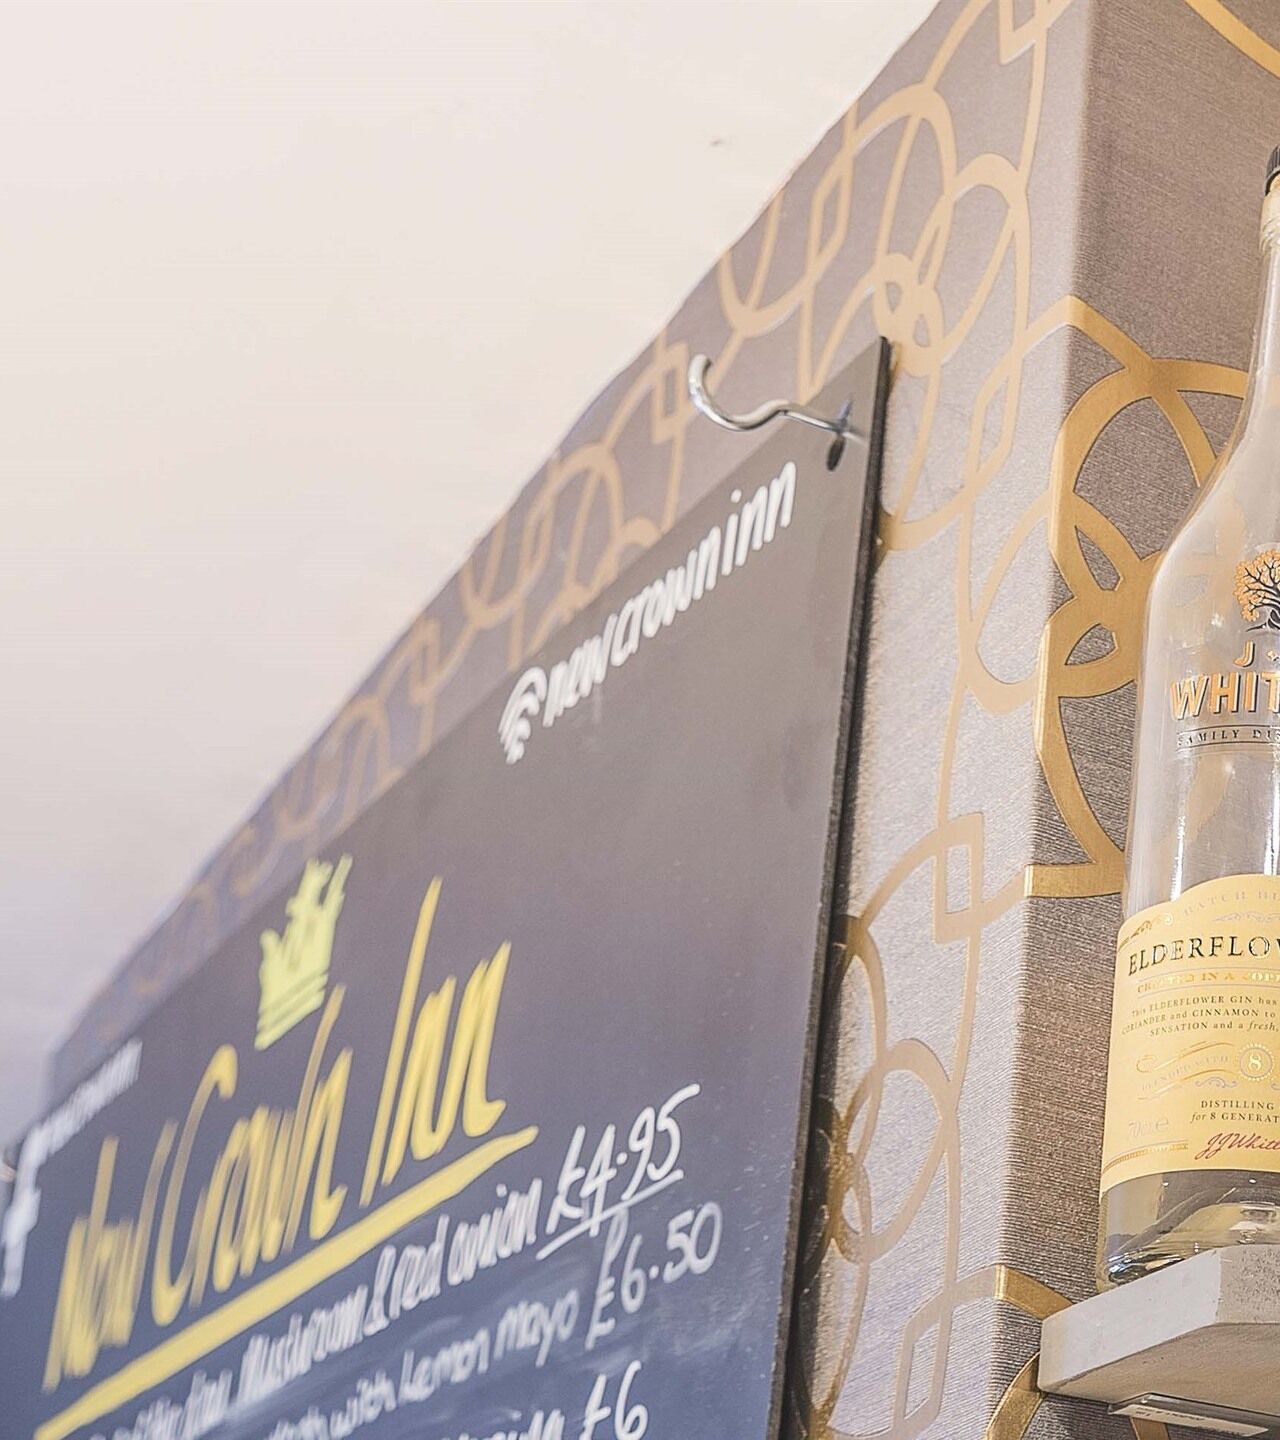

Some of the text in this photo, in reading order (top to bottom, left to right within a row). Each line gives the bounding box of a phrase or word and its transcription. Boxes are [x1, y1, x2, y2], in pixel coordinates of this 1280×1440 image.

[1190, 1112, 1207, 1125] for
[1209, 1111, 1217, 1120] 8
[1200, 1099, 1275, 1112] DISTILLING
[548, 1083, 701, 1237] £4.95
[584, 1201, 723, 1350] £6.50
